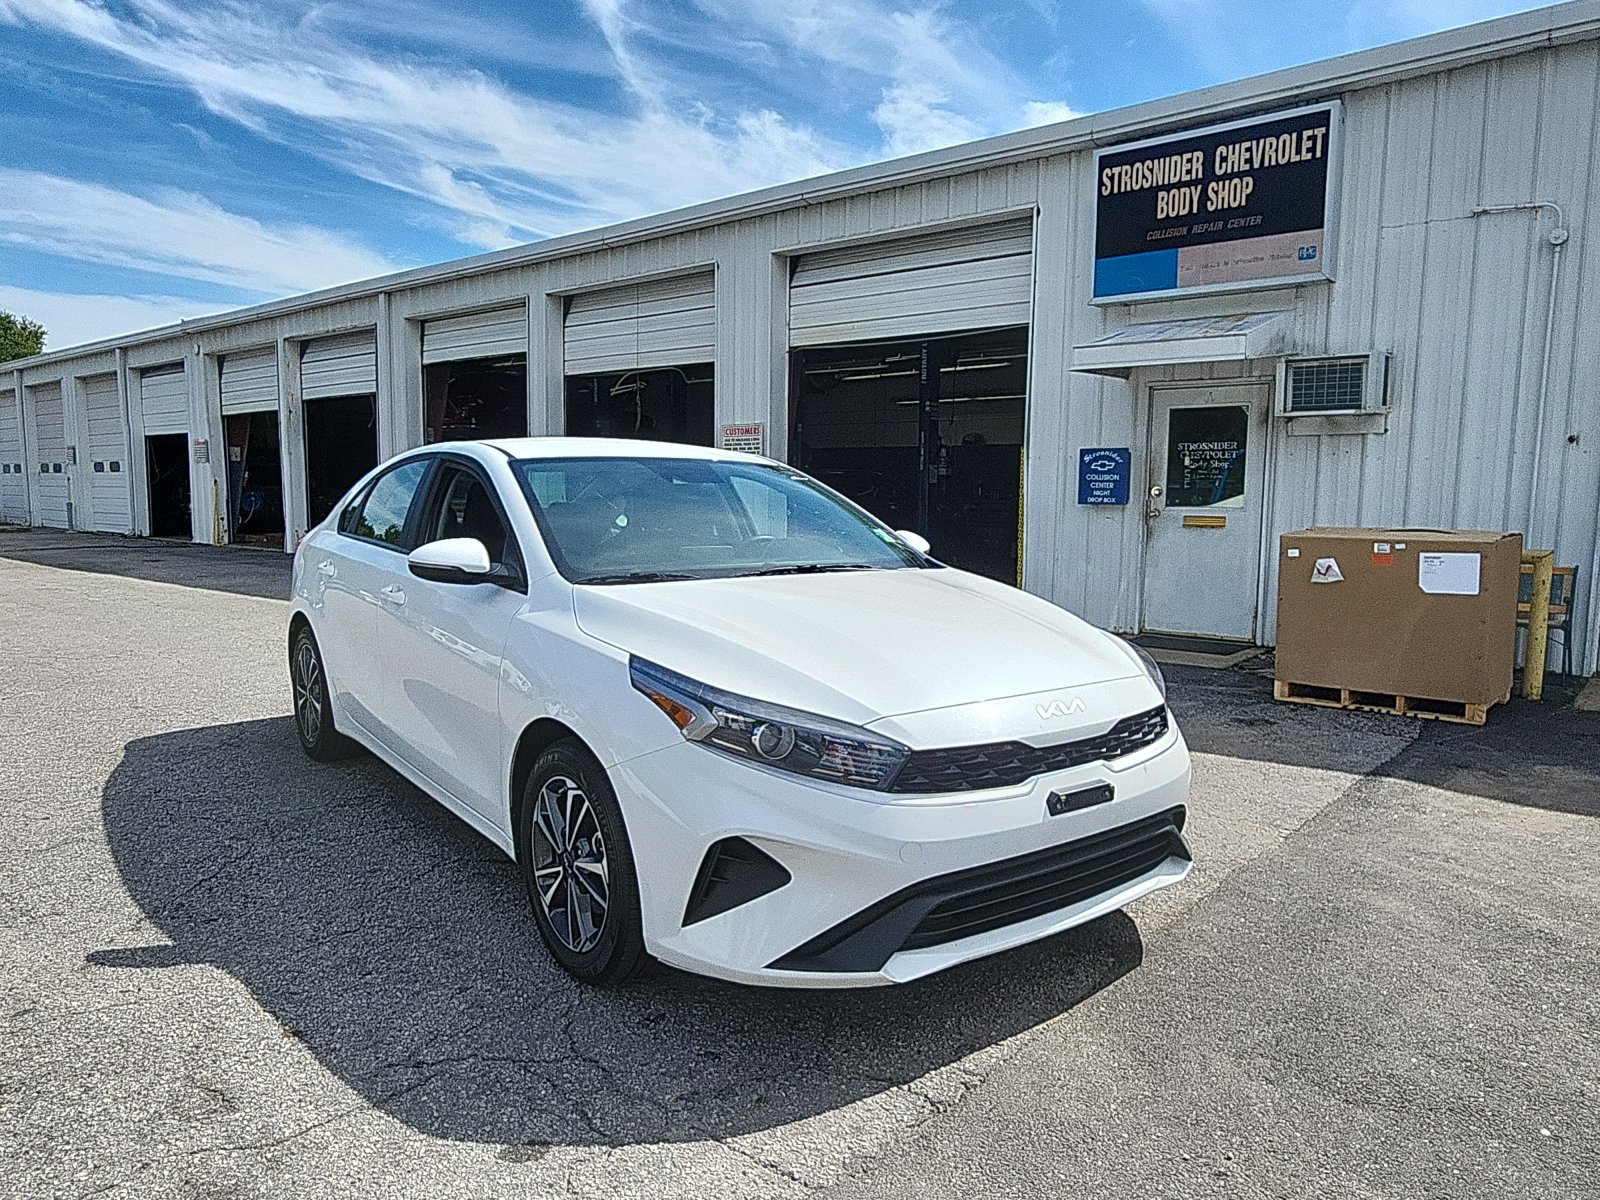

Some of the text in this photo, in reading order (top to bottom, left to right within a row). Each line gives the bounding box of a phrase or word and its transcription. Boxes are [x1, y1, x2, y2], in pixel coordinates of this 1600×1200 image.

[1101, 126, 1327, 196] STROSNIDER CHEVROLET
[1156, 176, 1254, 219] BODY SHOP
[1146, 215, 1263, 240] COLLISION REPAIR CENTER
[725, 426, 760, 436] CUSTOMERS
[1177, 441, 1238, 451] STROSNIDER
[1083, 451, 1124, 464] Strosnider
